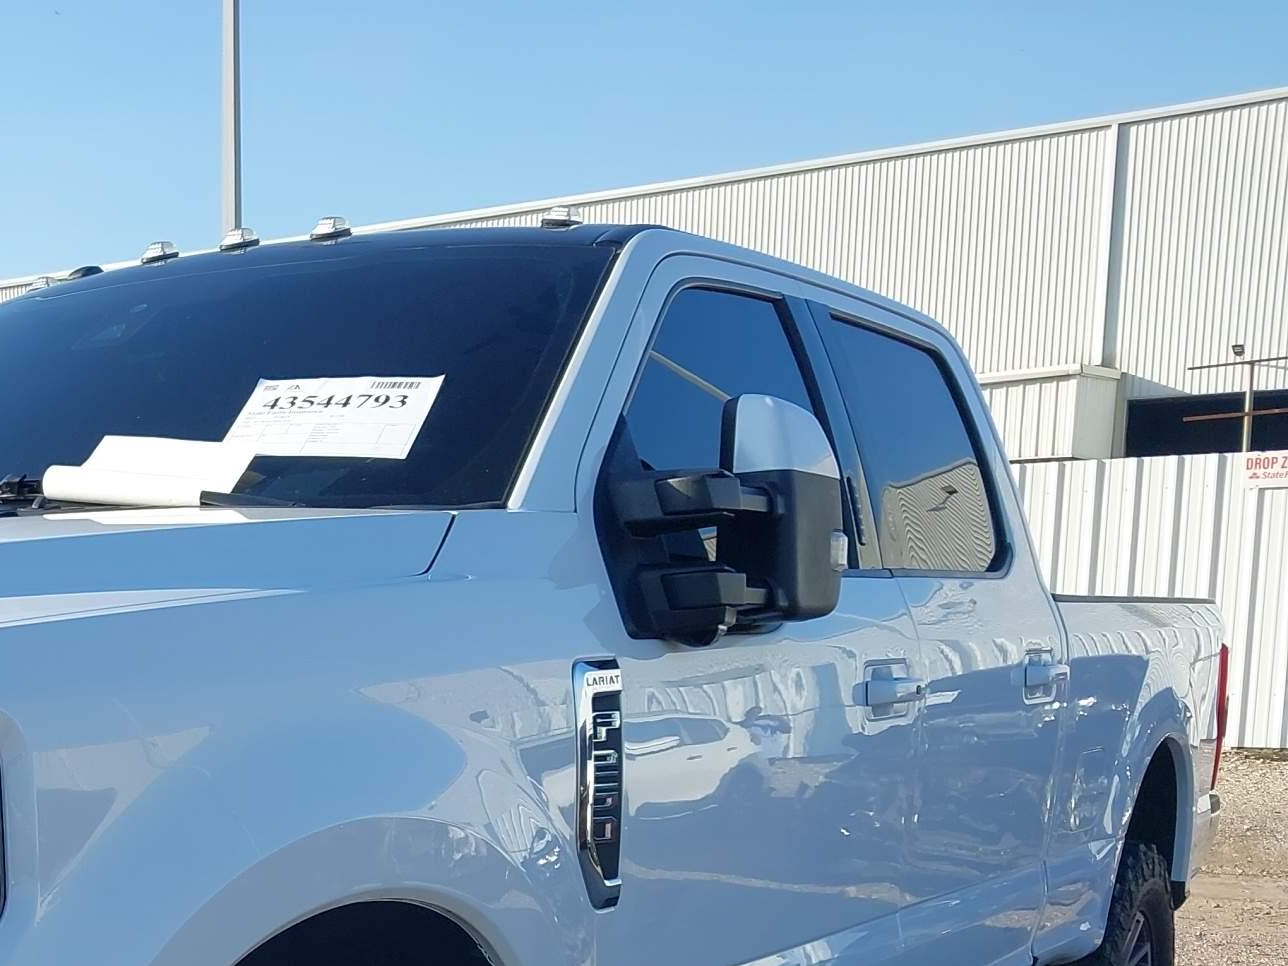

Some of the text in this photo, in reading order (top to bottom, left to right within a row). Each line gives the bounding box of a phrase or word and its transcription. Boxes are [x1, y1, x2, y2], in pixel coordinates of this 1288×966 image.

[262, 394, 409, 410] 43544793
[1246, 456, 1279, 470] DROP
[586, 674, 620, 687] LARIAT
